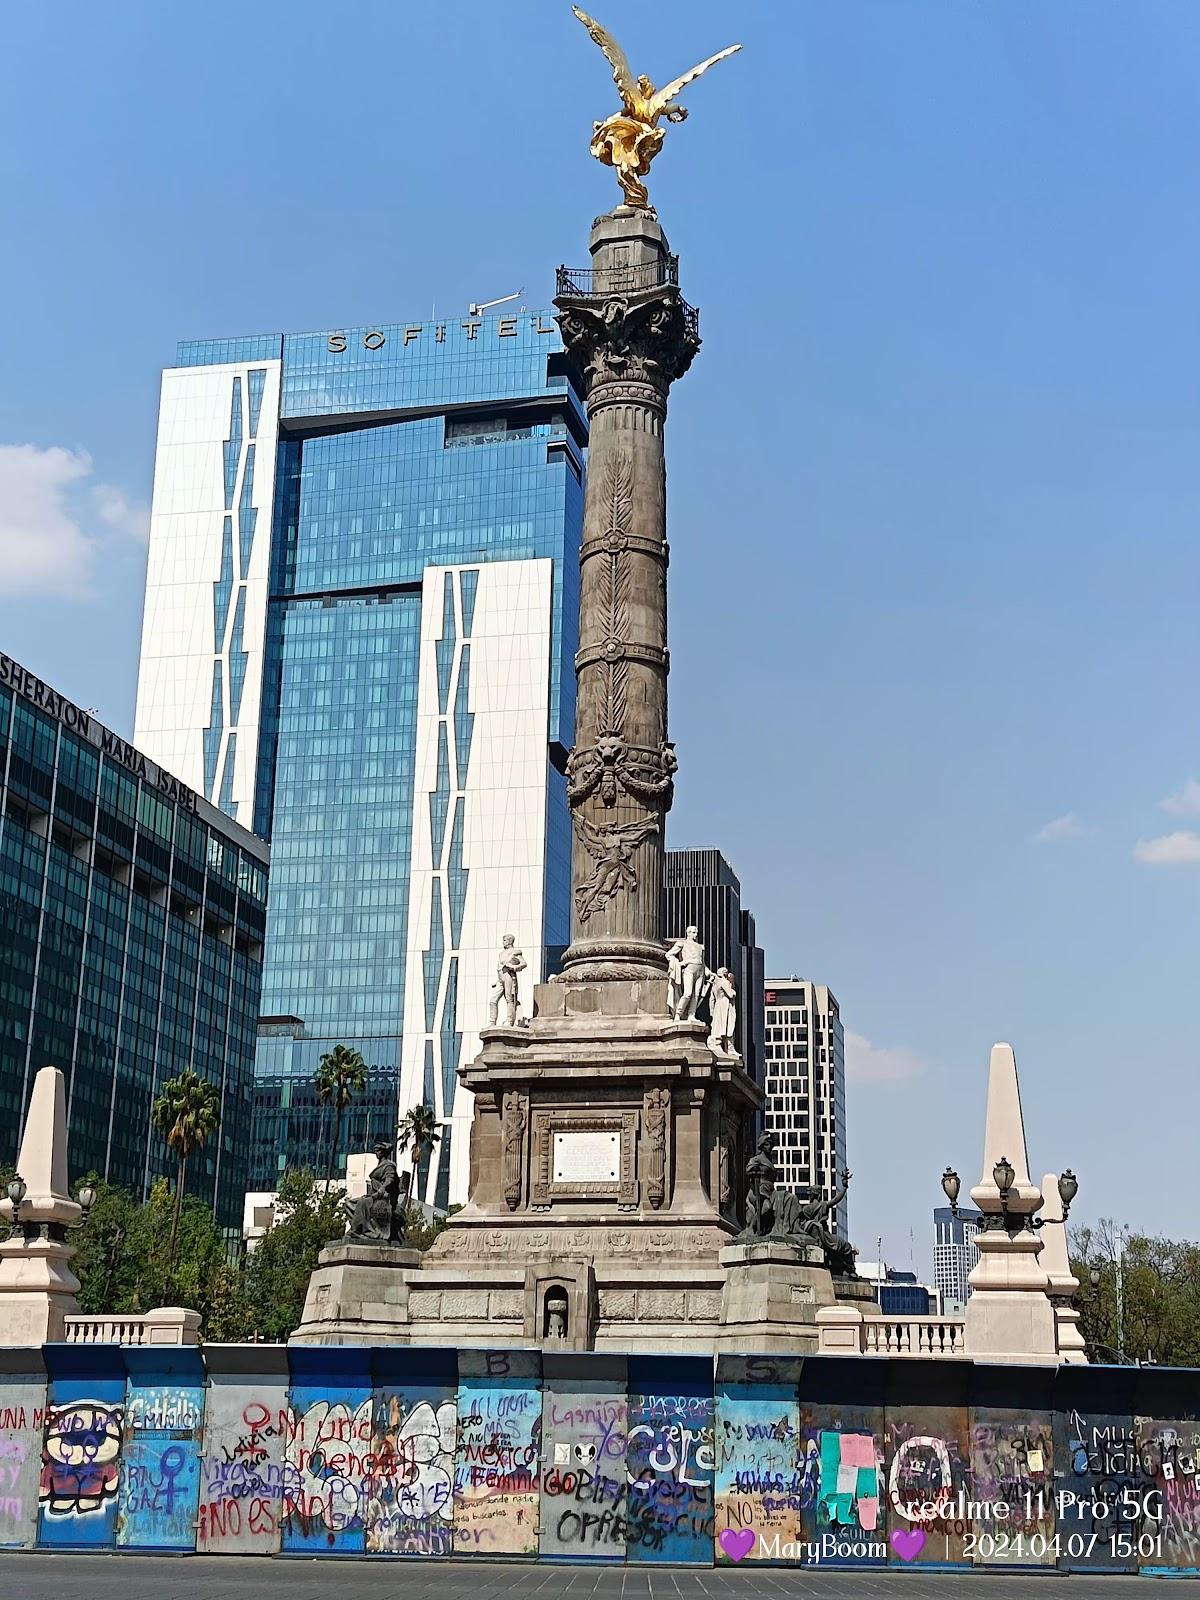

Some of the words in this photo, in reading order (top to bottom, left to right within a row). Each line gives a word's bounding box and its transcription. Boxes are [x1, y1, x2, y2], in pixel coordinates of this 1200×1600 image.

[327, 316, 555, 353] SOFITEL
[0, 654, 90, 737] SHERATON
[101, 726, 148, 779] MARIA
[156, 767, 200, 816] ISABEL
[726, 1501, 753, 1528] NO
